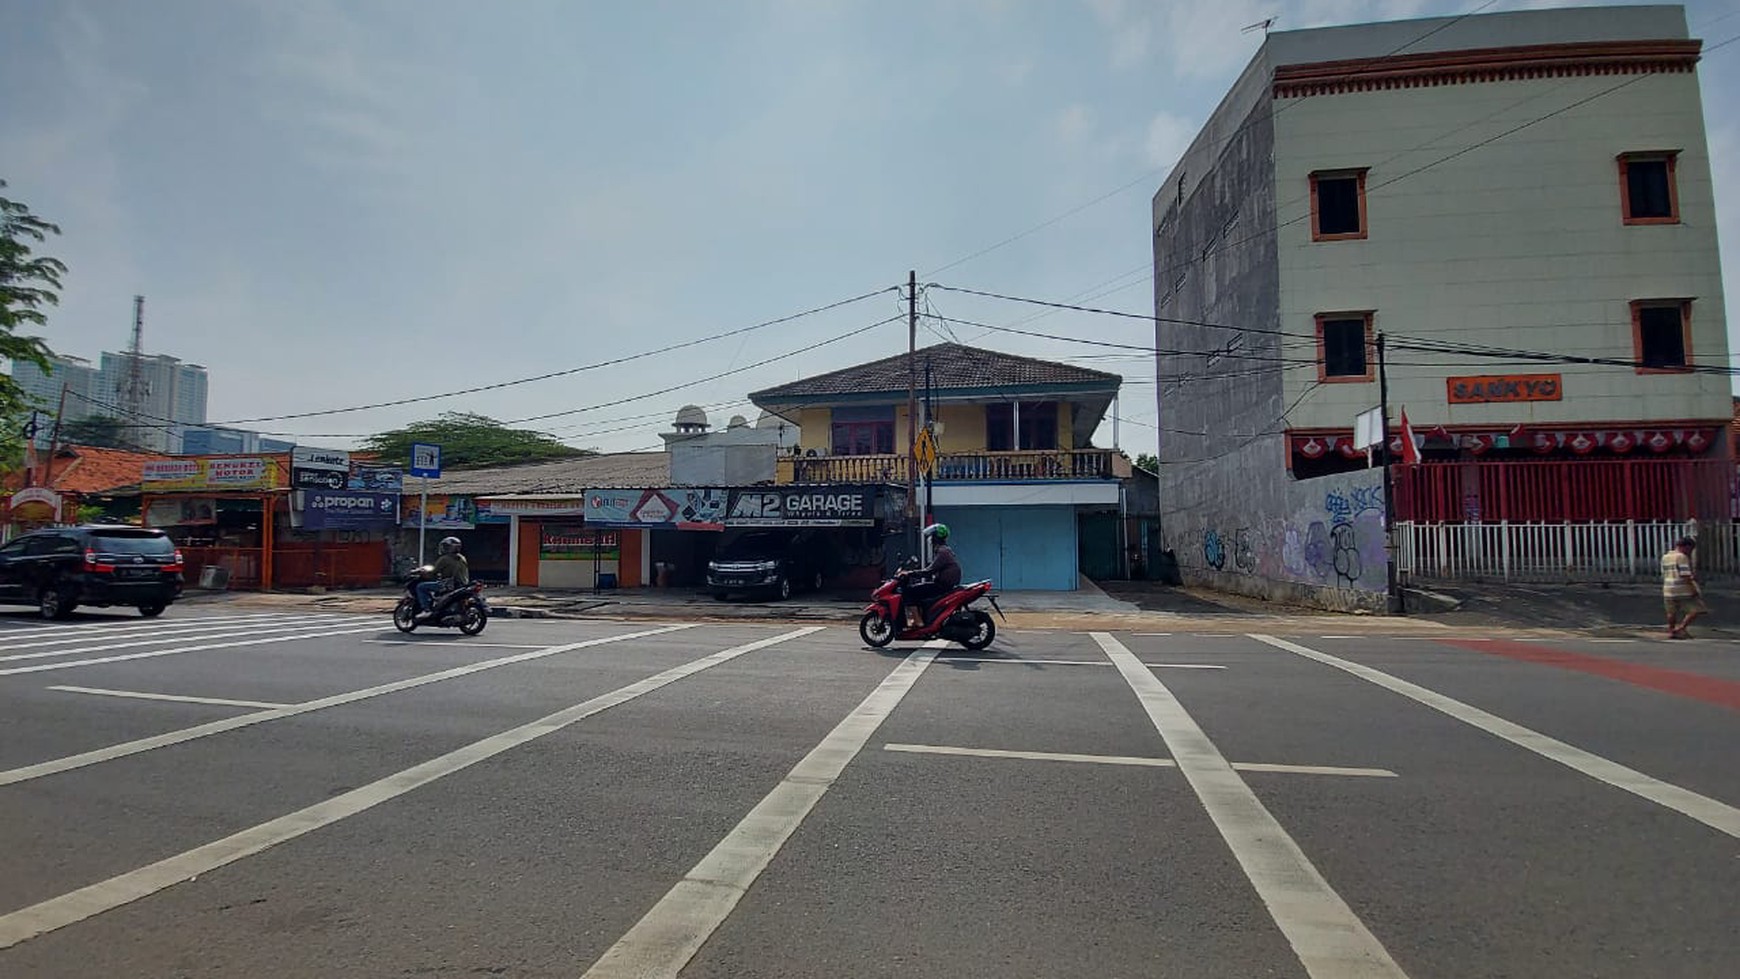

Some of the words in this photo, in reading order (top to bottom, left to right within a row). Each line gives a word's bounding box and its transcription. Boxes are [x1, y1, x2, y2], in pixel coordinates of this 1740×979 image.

[1454, 379, 1557, 399] SANKYO
[324, 496, 374, 508] propan
[731, 494, 781, 517] M2
[786, 494, 863, 511] GARAGE
